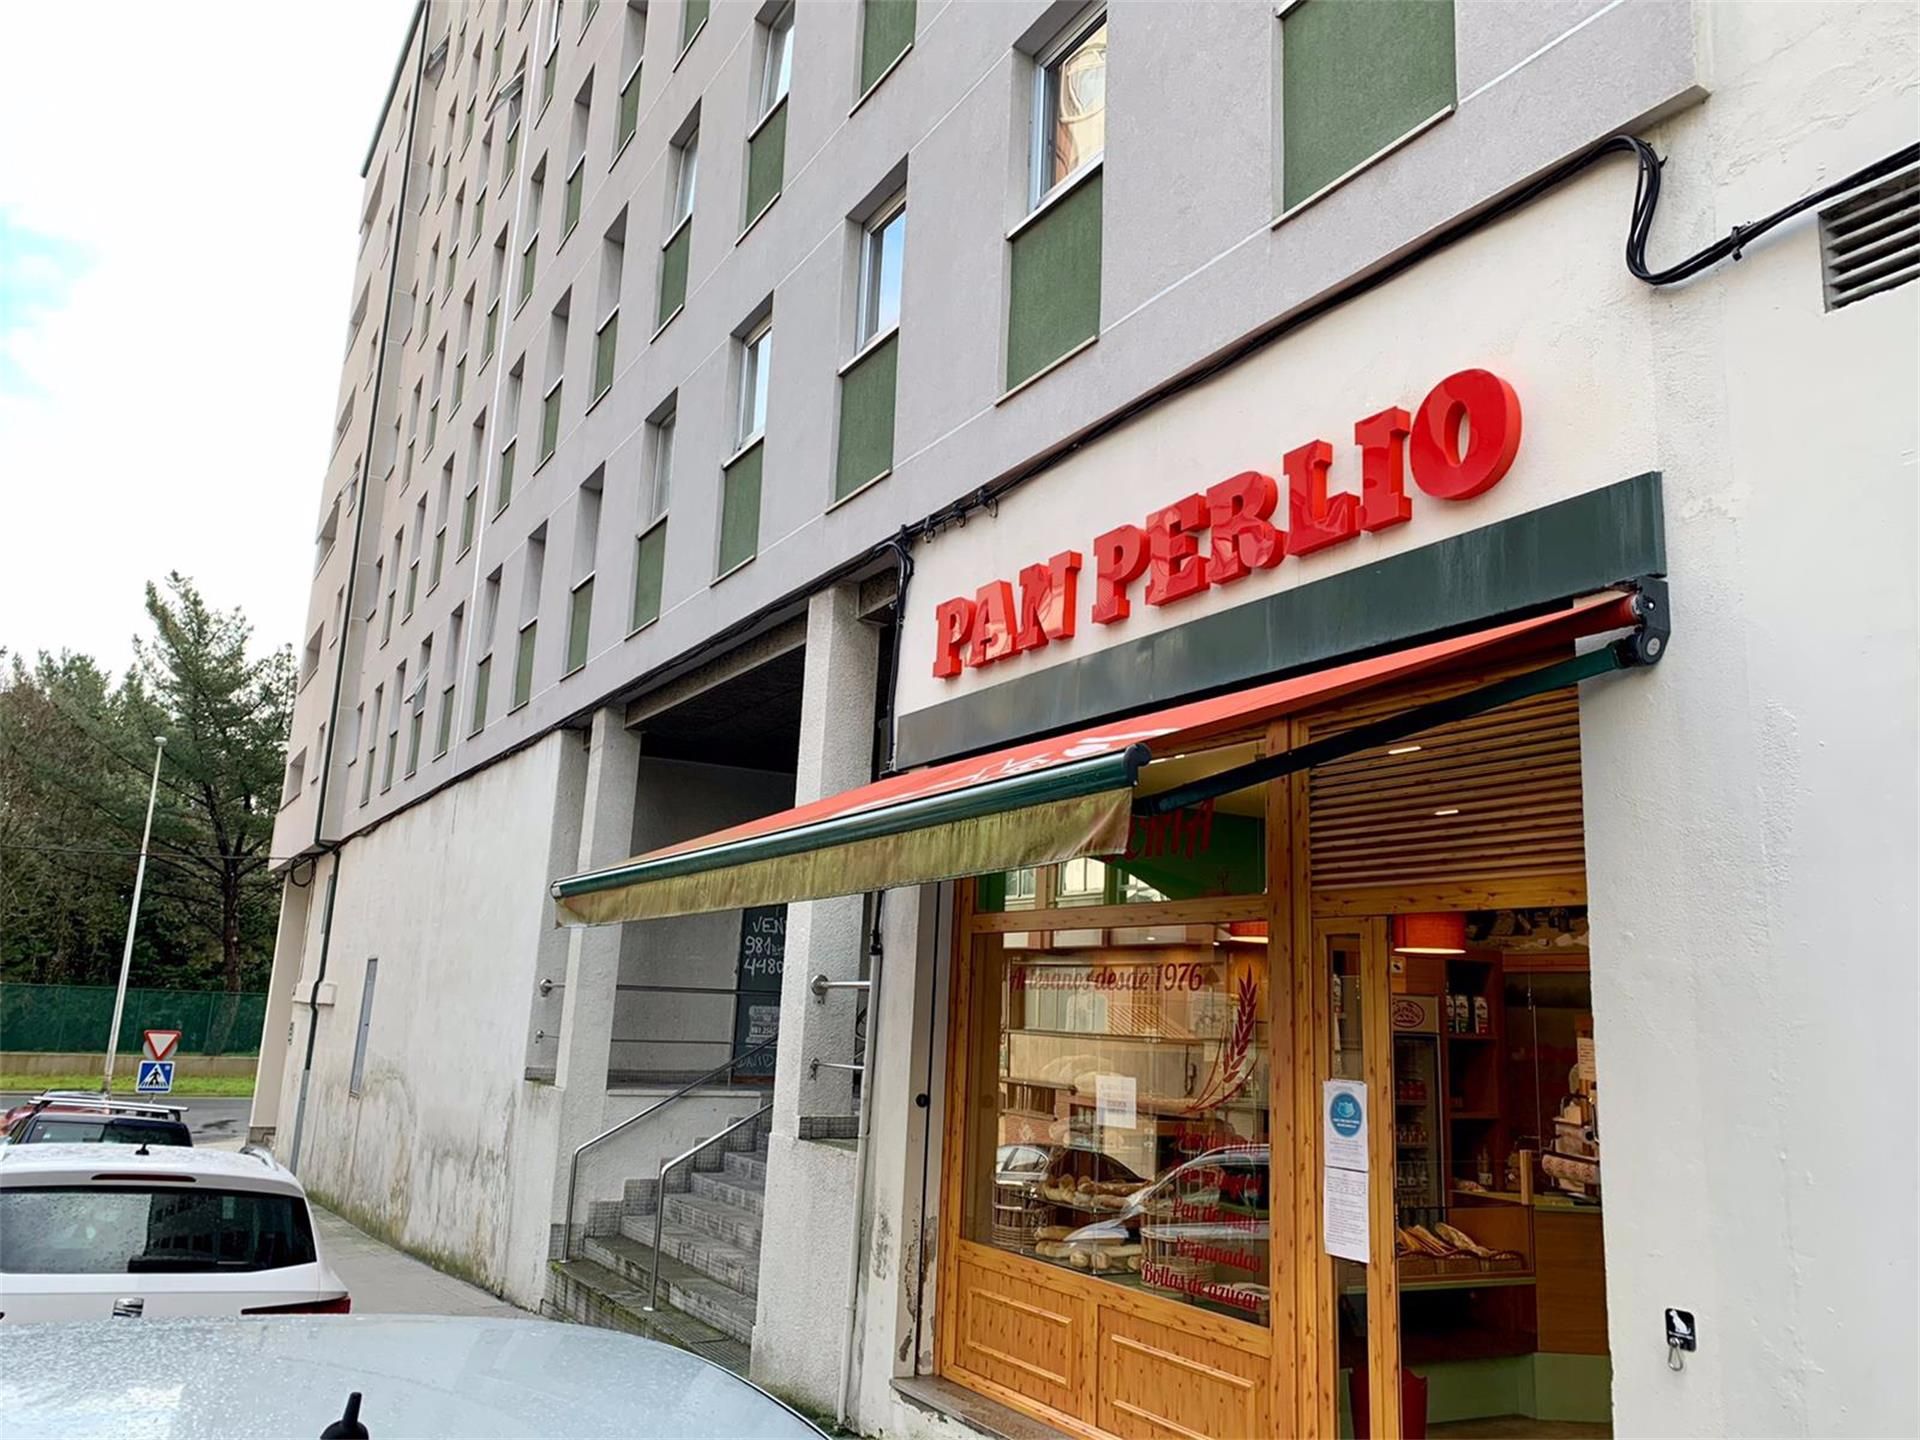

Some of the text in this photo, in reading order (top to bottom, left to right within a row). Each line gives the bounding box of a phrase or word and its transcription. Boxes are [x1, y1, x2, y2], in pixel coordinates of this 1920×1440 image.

[932, 368, 1522, 680] PAN PERLIO
[752, 915, 786, 935] VEN
[1096, 965, 1150, 992] desde
[1154, 962, 1203, 992] 1976
[1173, 1196, 1199, 1220] Pan
[1142, 1258, 1185, 1292] Bollas
[1187, 1273, 1204, 1297] de
